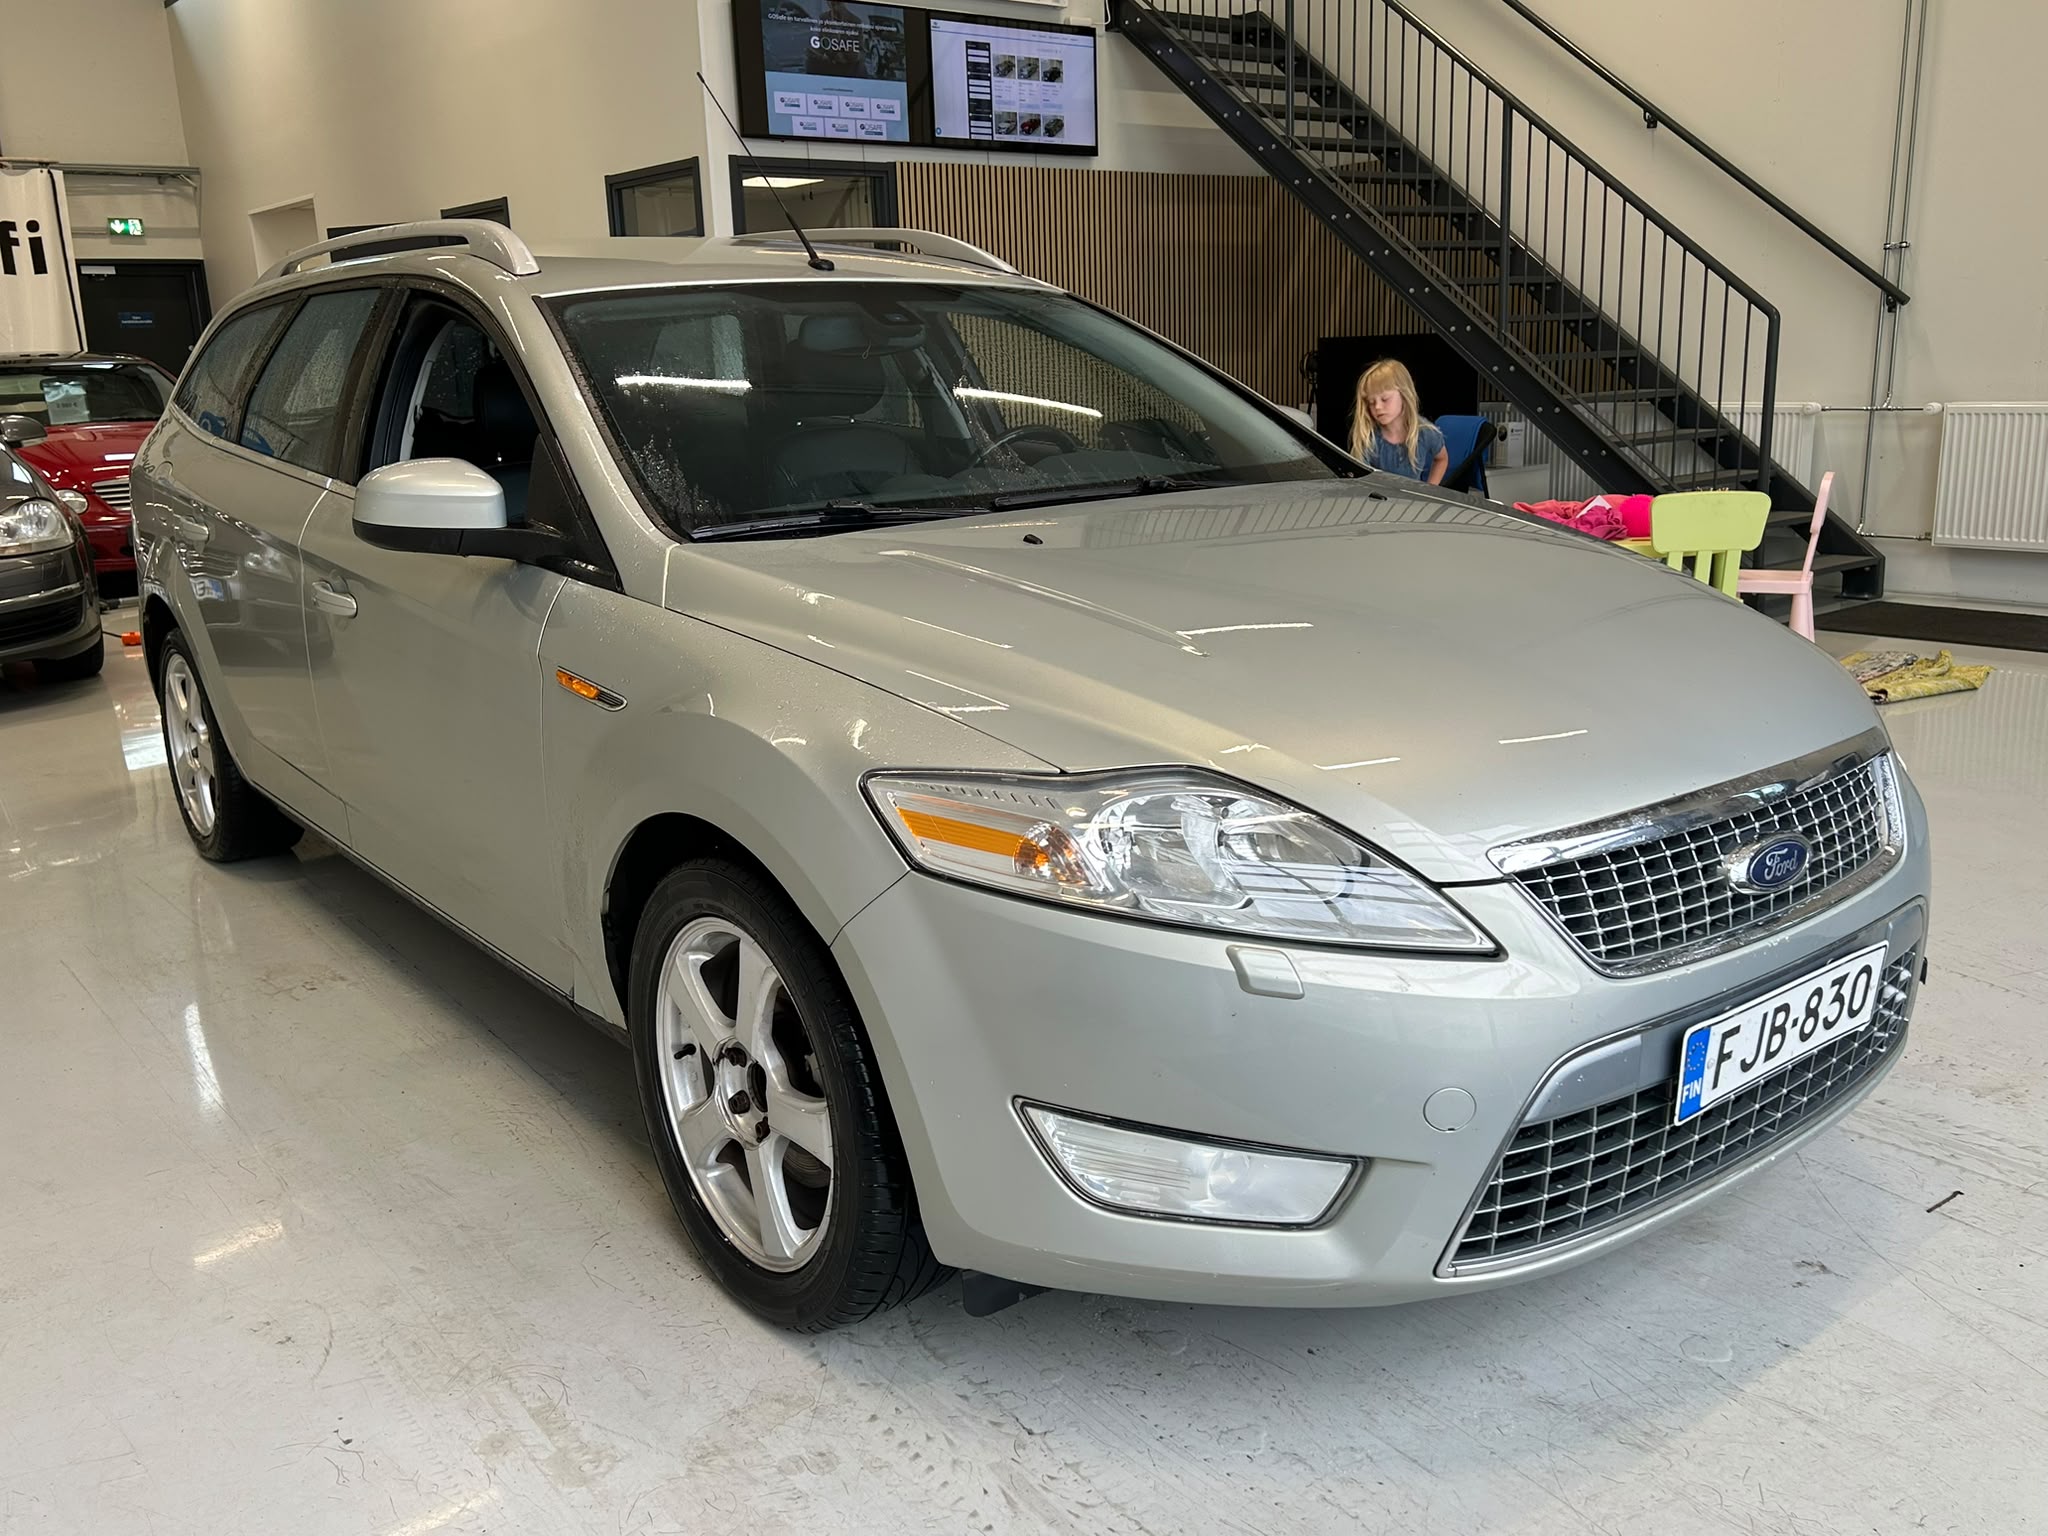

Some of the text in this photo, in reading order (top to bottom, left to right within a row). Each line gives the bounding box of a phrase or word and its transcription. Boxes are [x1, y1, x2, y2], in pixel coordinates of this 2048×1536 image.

[810, 36, 860, 53] GOSAFE
[1764, 847, 1799, 881] Ford
[1711, 963, 1873, 1090] FJB-830
[1681, 1077, 1702, 1104] FIN
